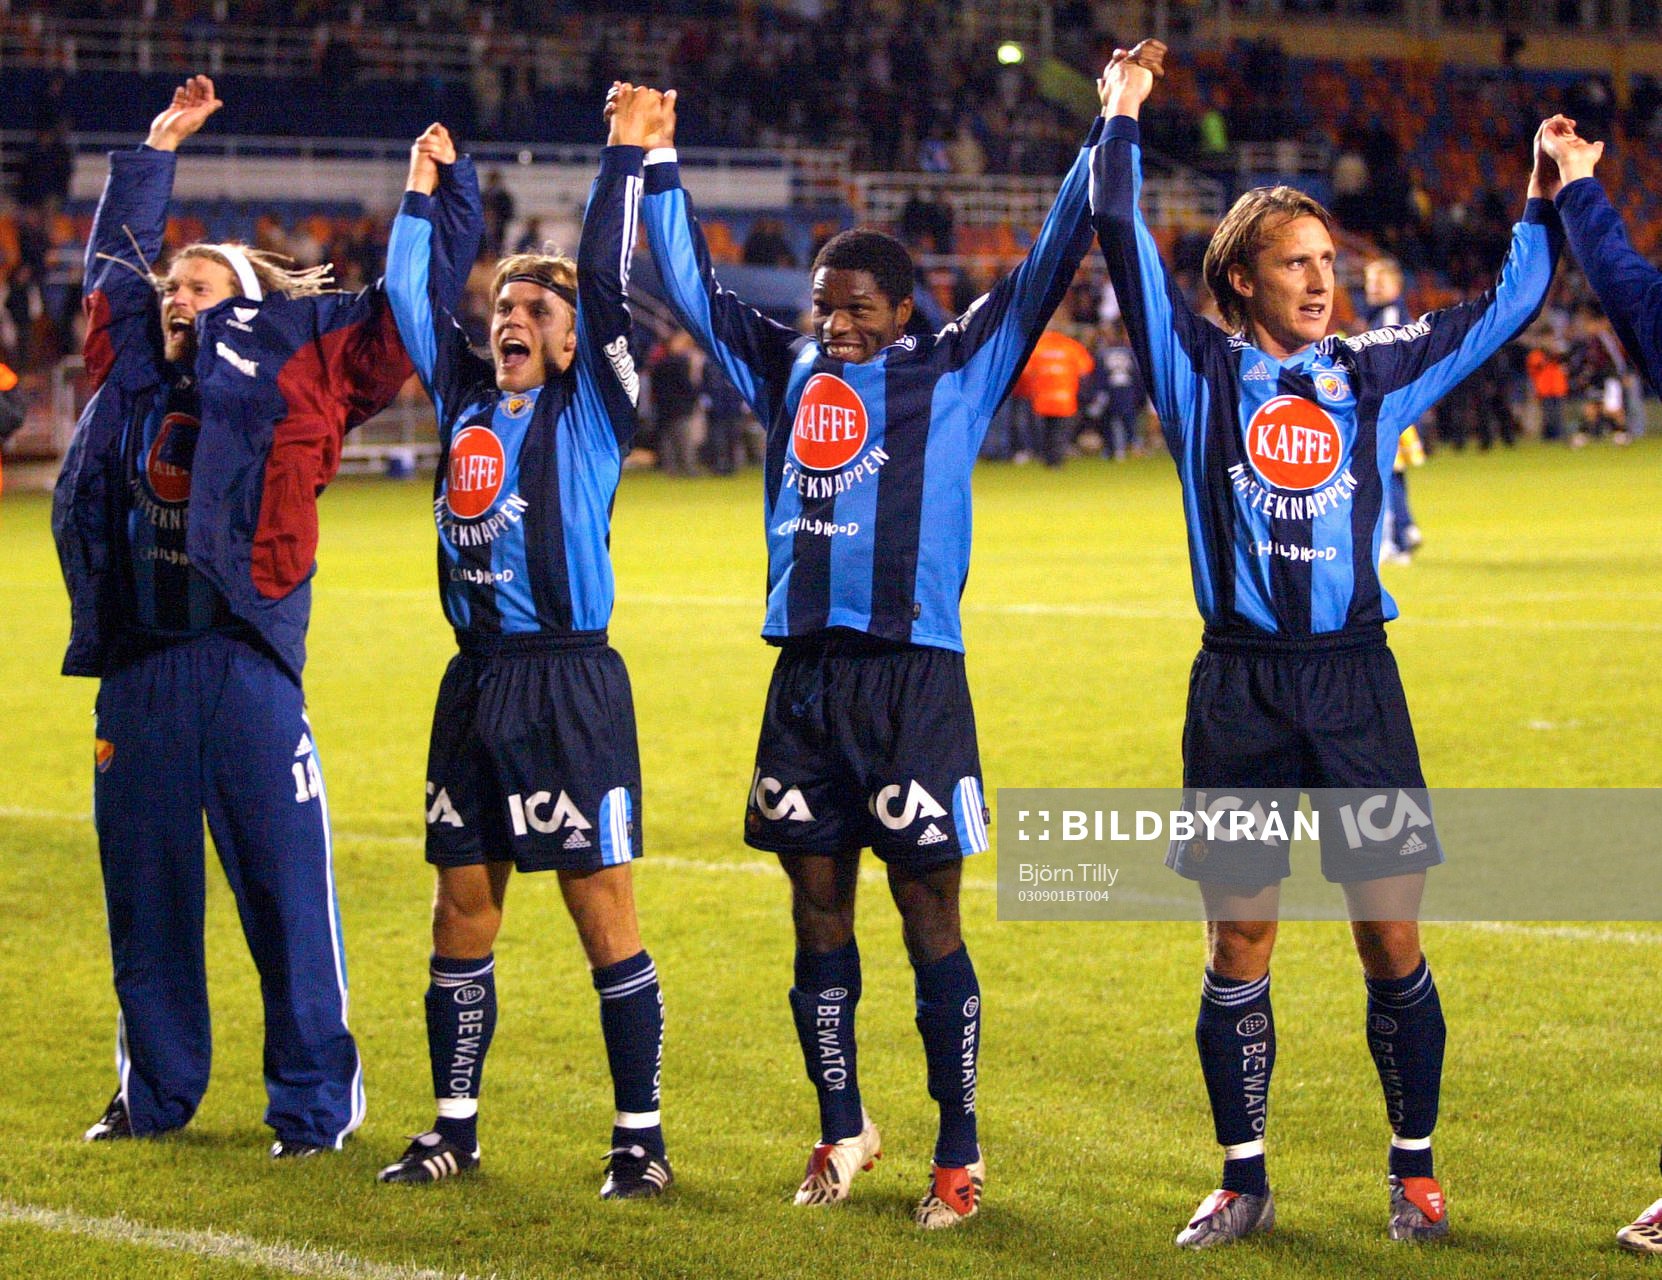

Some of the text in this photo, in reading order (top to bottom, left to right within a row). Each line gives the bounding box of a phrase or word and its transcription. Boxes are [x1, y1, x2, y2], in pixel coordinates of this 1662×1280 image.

[796, 404, 859, 442] KAFFE
[1255, 424, 1333, 464] KAFFE
[450, 455, 498, 491] KAFFE
[778, 518, 859, 537] CHILDHOOD
[1248, 541, 1337, 562] CHILDHOOD
[508, 789, 592, 836] ICA
[869, 778, 948, 830] CA
[1339, 788, 1431, 850] ICA
[917, 833, 948, 846] adidas
[450, 1010, 484, 1100] BEWATOR
[816, 1005, 848, 1091] BEWATOR
[961, 1021, 977, 1115] BEWATOR
[1243, 1041, 1266, 1139] BEWATO
